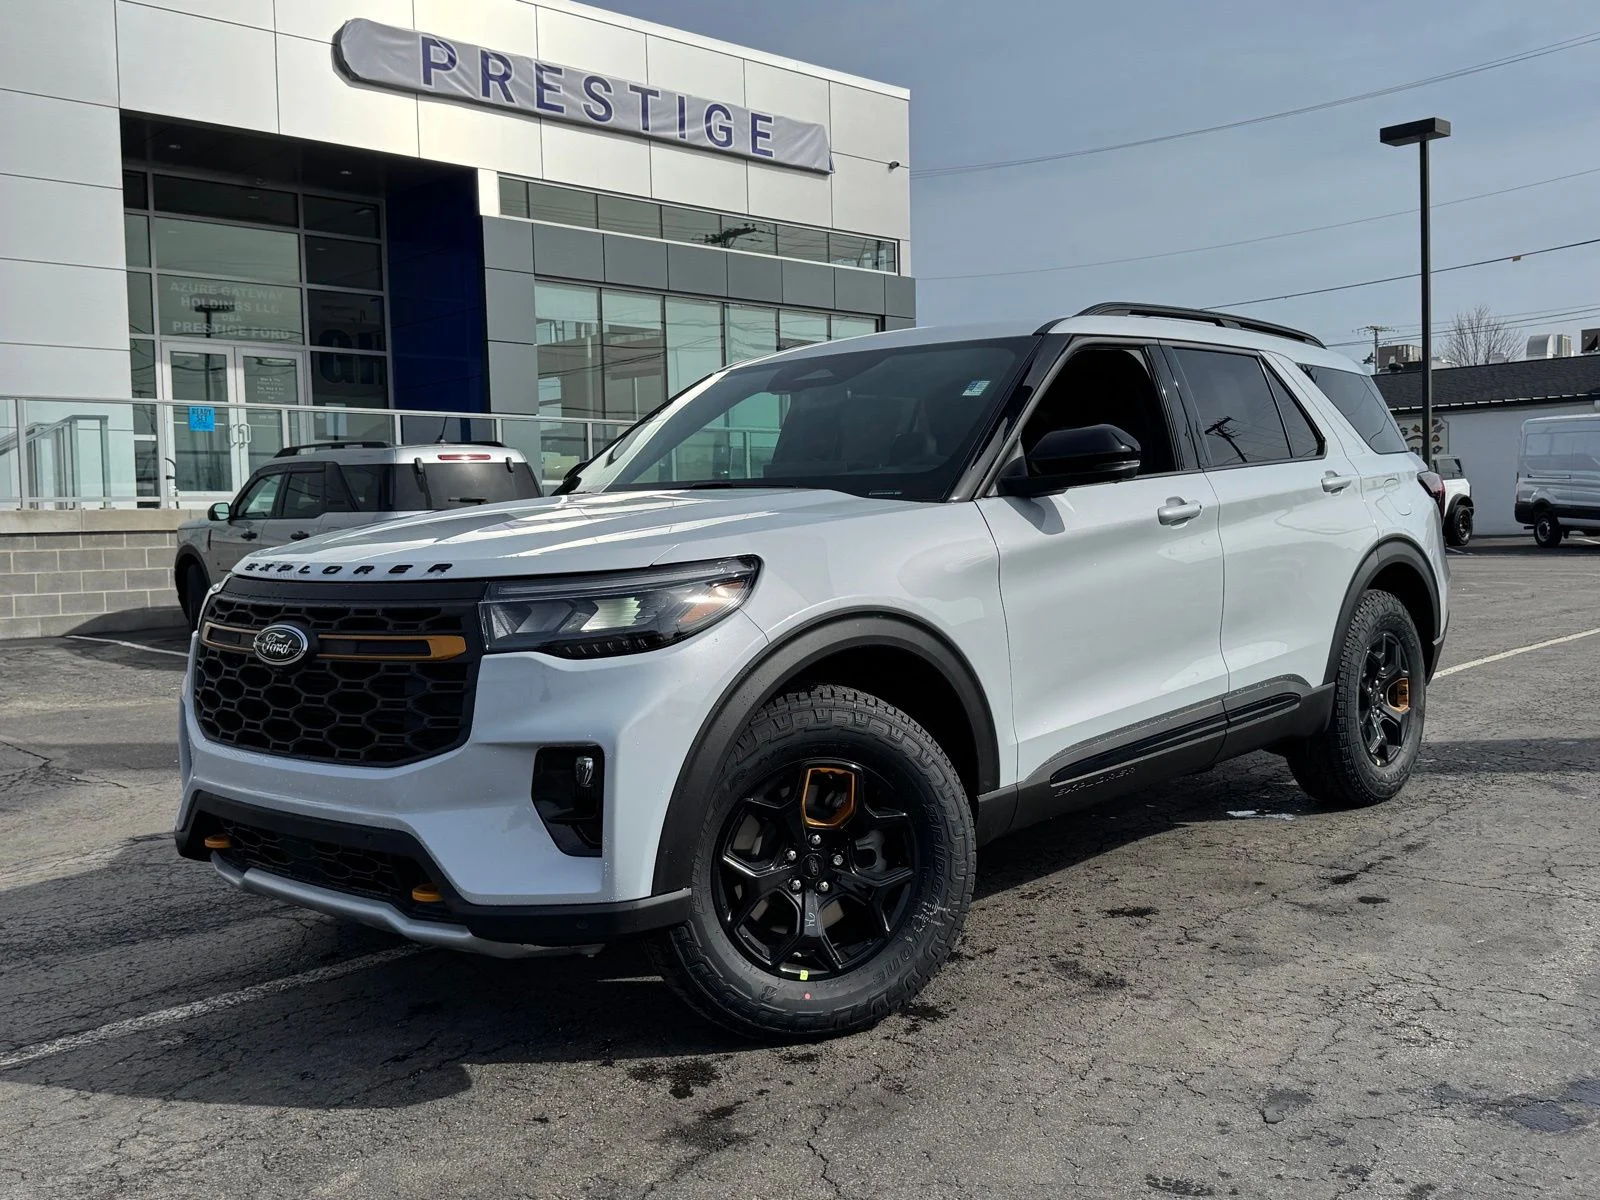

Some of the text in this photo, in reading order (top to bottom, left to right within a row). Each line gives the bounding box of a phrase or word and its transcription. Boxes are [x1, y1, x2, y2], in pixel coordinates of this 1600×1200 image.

[421, 35, 775, 158] PRESTIGE
[169, 281, 217, 295] AZURE
[172, 321, 291, 340] PRESTIGE FORD
[244, 563, 453, 575] EXPLORER
[261, 633, 291, 655] Ford
